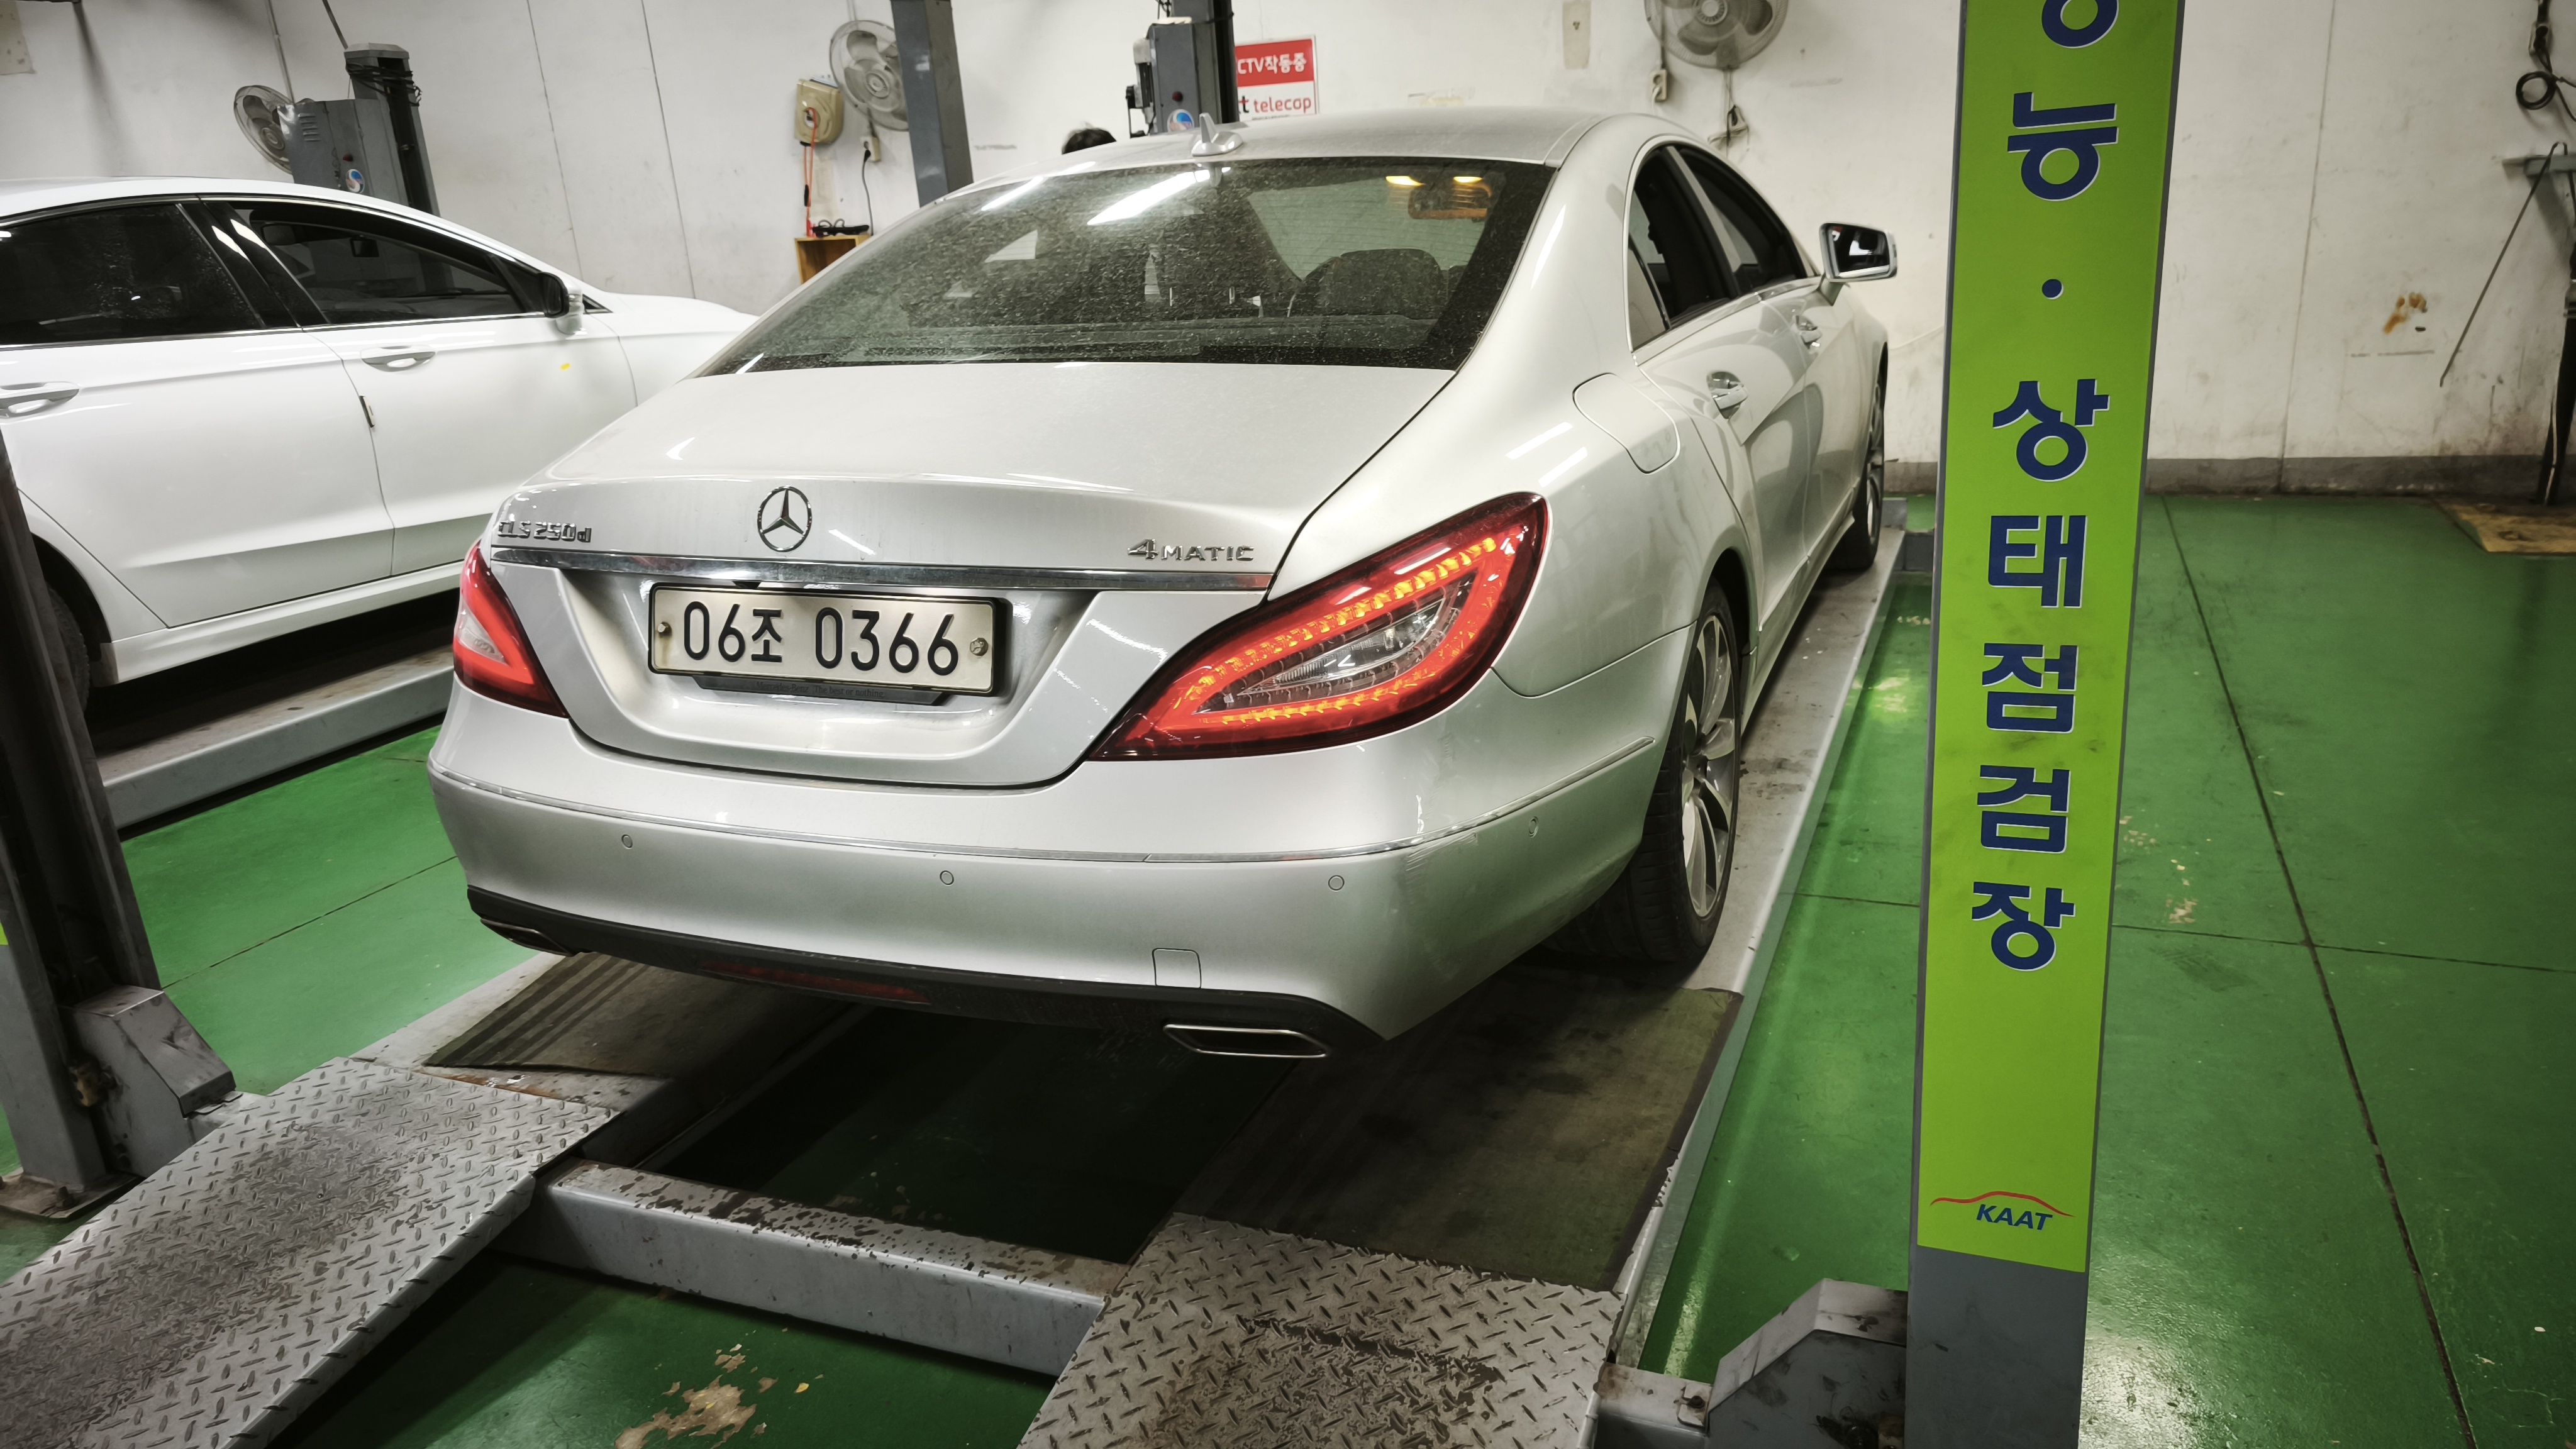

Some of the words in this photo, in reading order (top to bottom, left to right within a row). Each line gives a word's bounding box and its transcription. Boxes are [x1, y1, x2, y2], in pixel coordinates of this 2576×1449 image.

[1237, 52, 1307, 75] CTV작동중
[1238, 96, 1250, 114] t
[1253, 96, 1312, 114] telecop
[497, 520, 531, 538] CLS
[1127, 538, 1255, 562] 4MATIC
[684, 601, 782, 663] 06조
[815, 607, 959, 676] 0366
[814, 685, 828, 694] The
[830, 686, 844, 695] best
[1976, 1204, 2053, 1231] KAAT
